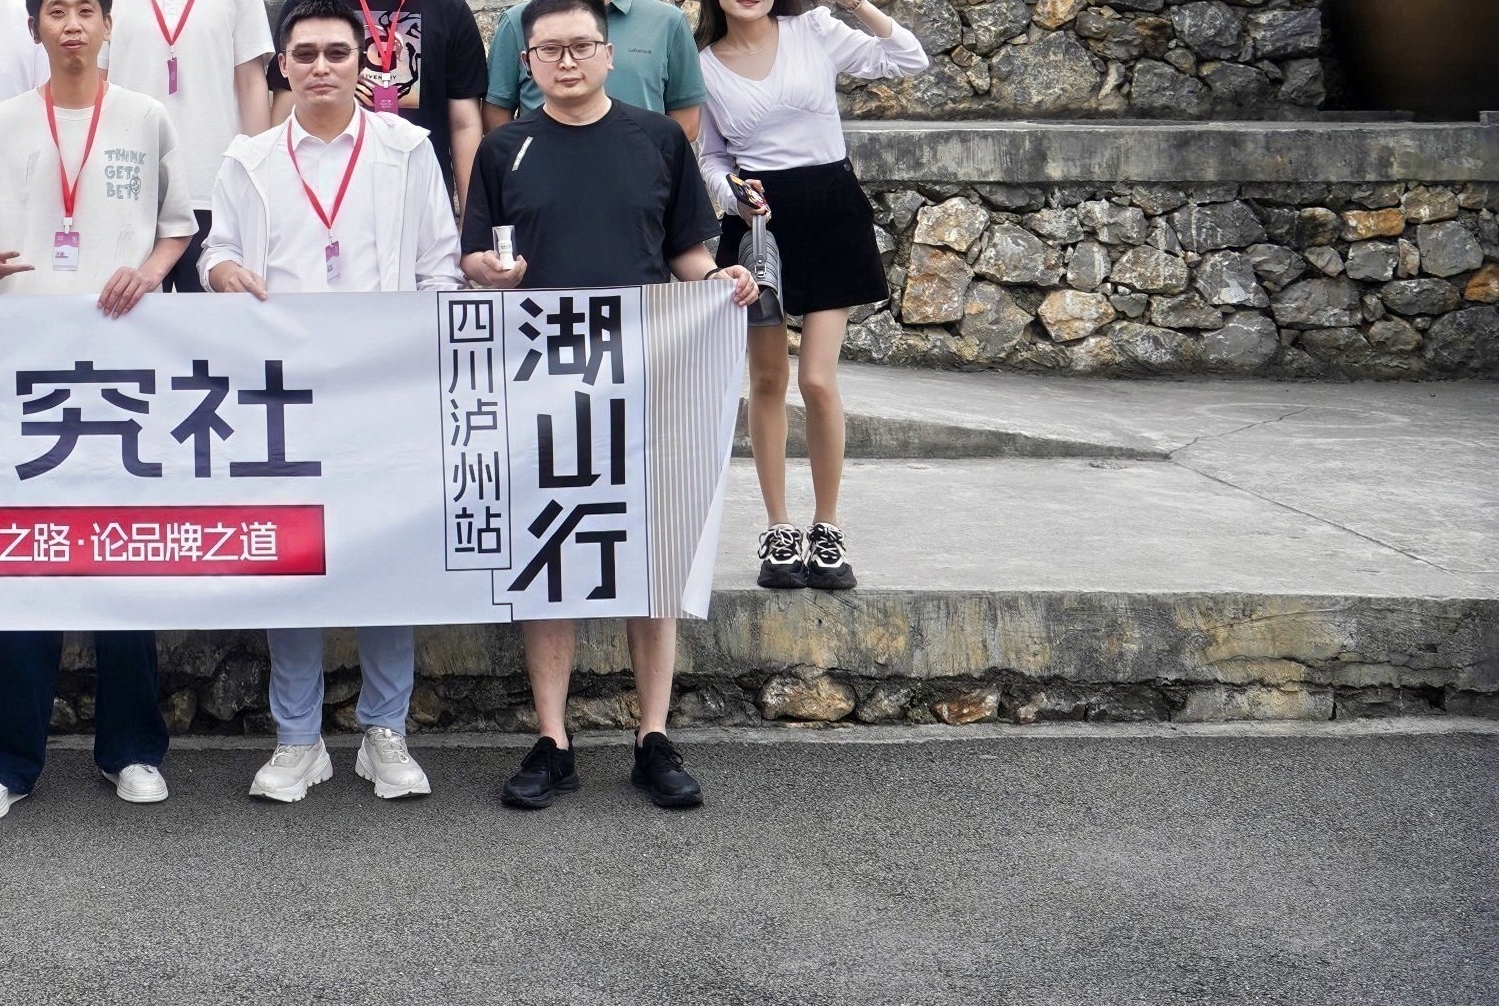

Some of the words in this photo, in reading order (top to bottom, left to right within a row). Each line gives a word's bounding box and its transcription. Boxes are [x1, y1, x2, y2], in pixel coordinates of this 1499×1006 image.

[104, 148, 146, 165] THINK
[448, 299, 502, 554] 四川泸州站
[507, 294, 627, 602] 湖山行
